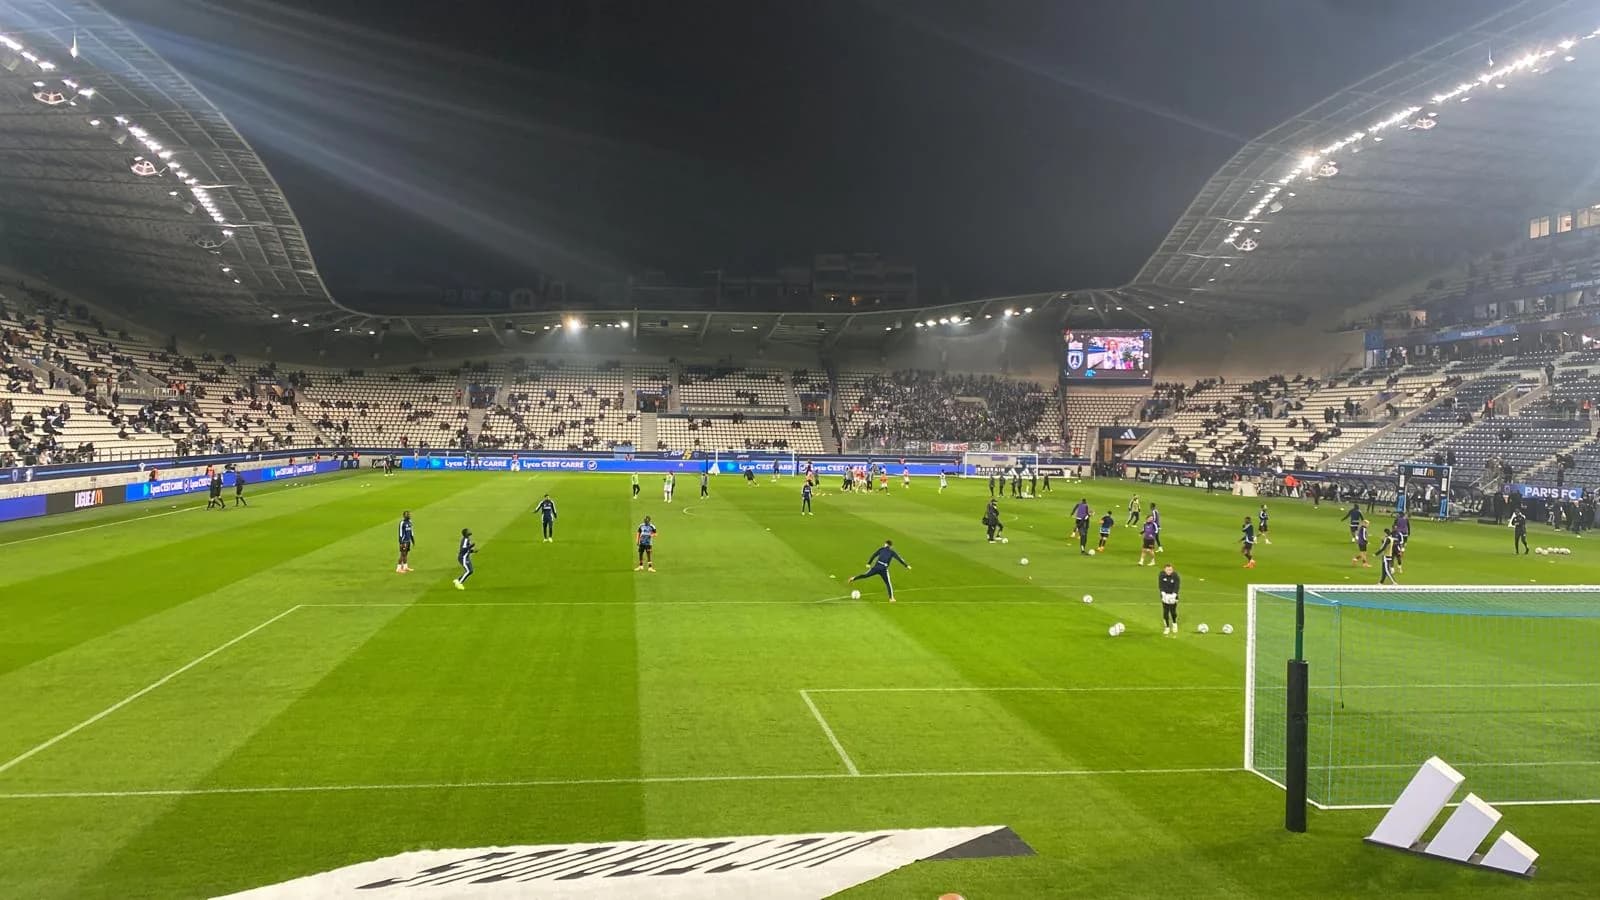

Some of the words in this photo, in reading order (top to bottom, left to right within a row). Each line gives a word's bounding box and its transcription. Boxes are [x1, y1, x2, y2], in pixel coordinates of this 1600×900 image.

[1524, 487, 1559, 498] PARIS
[1561, 489, 1577, 499] FC
[355, 834, 891, 890] VICTORIOUS
